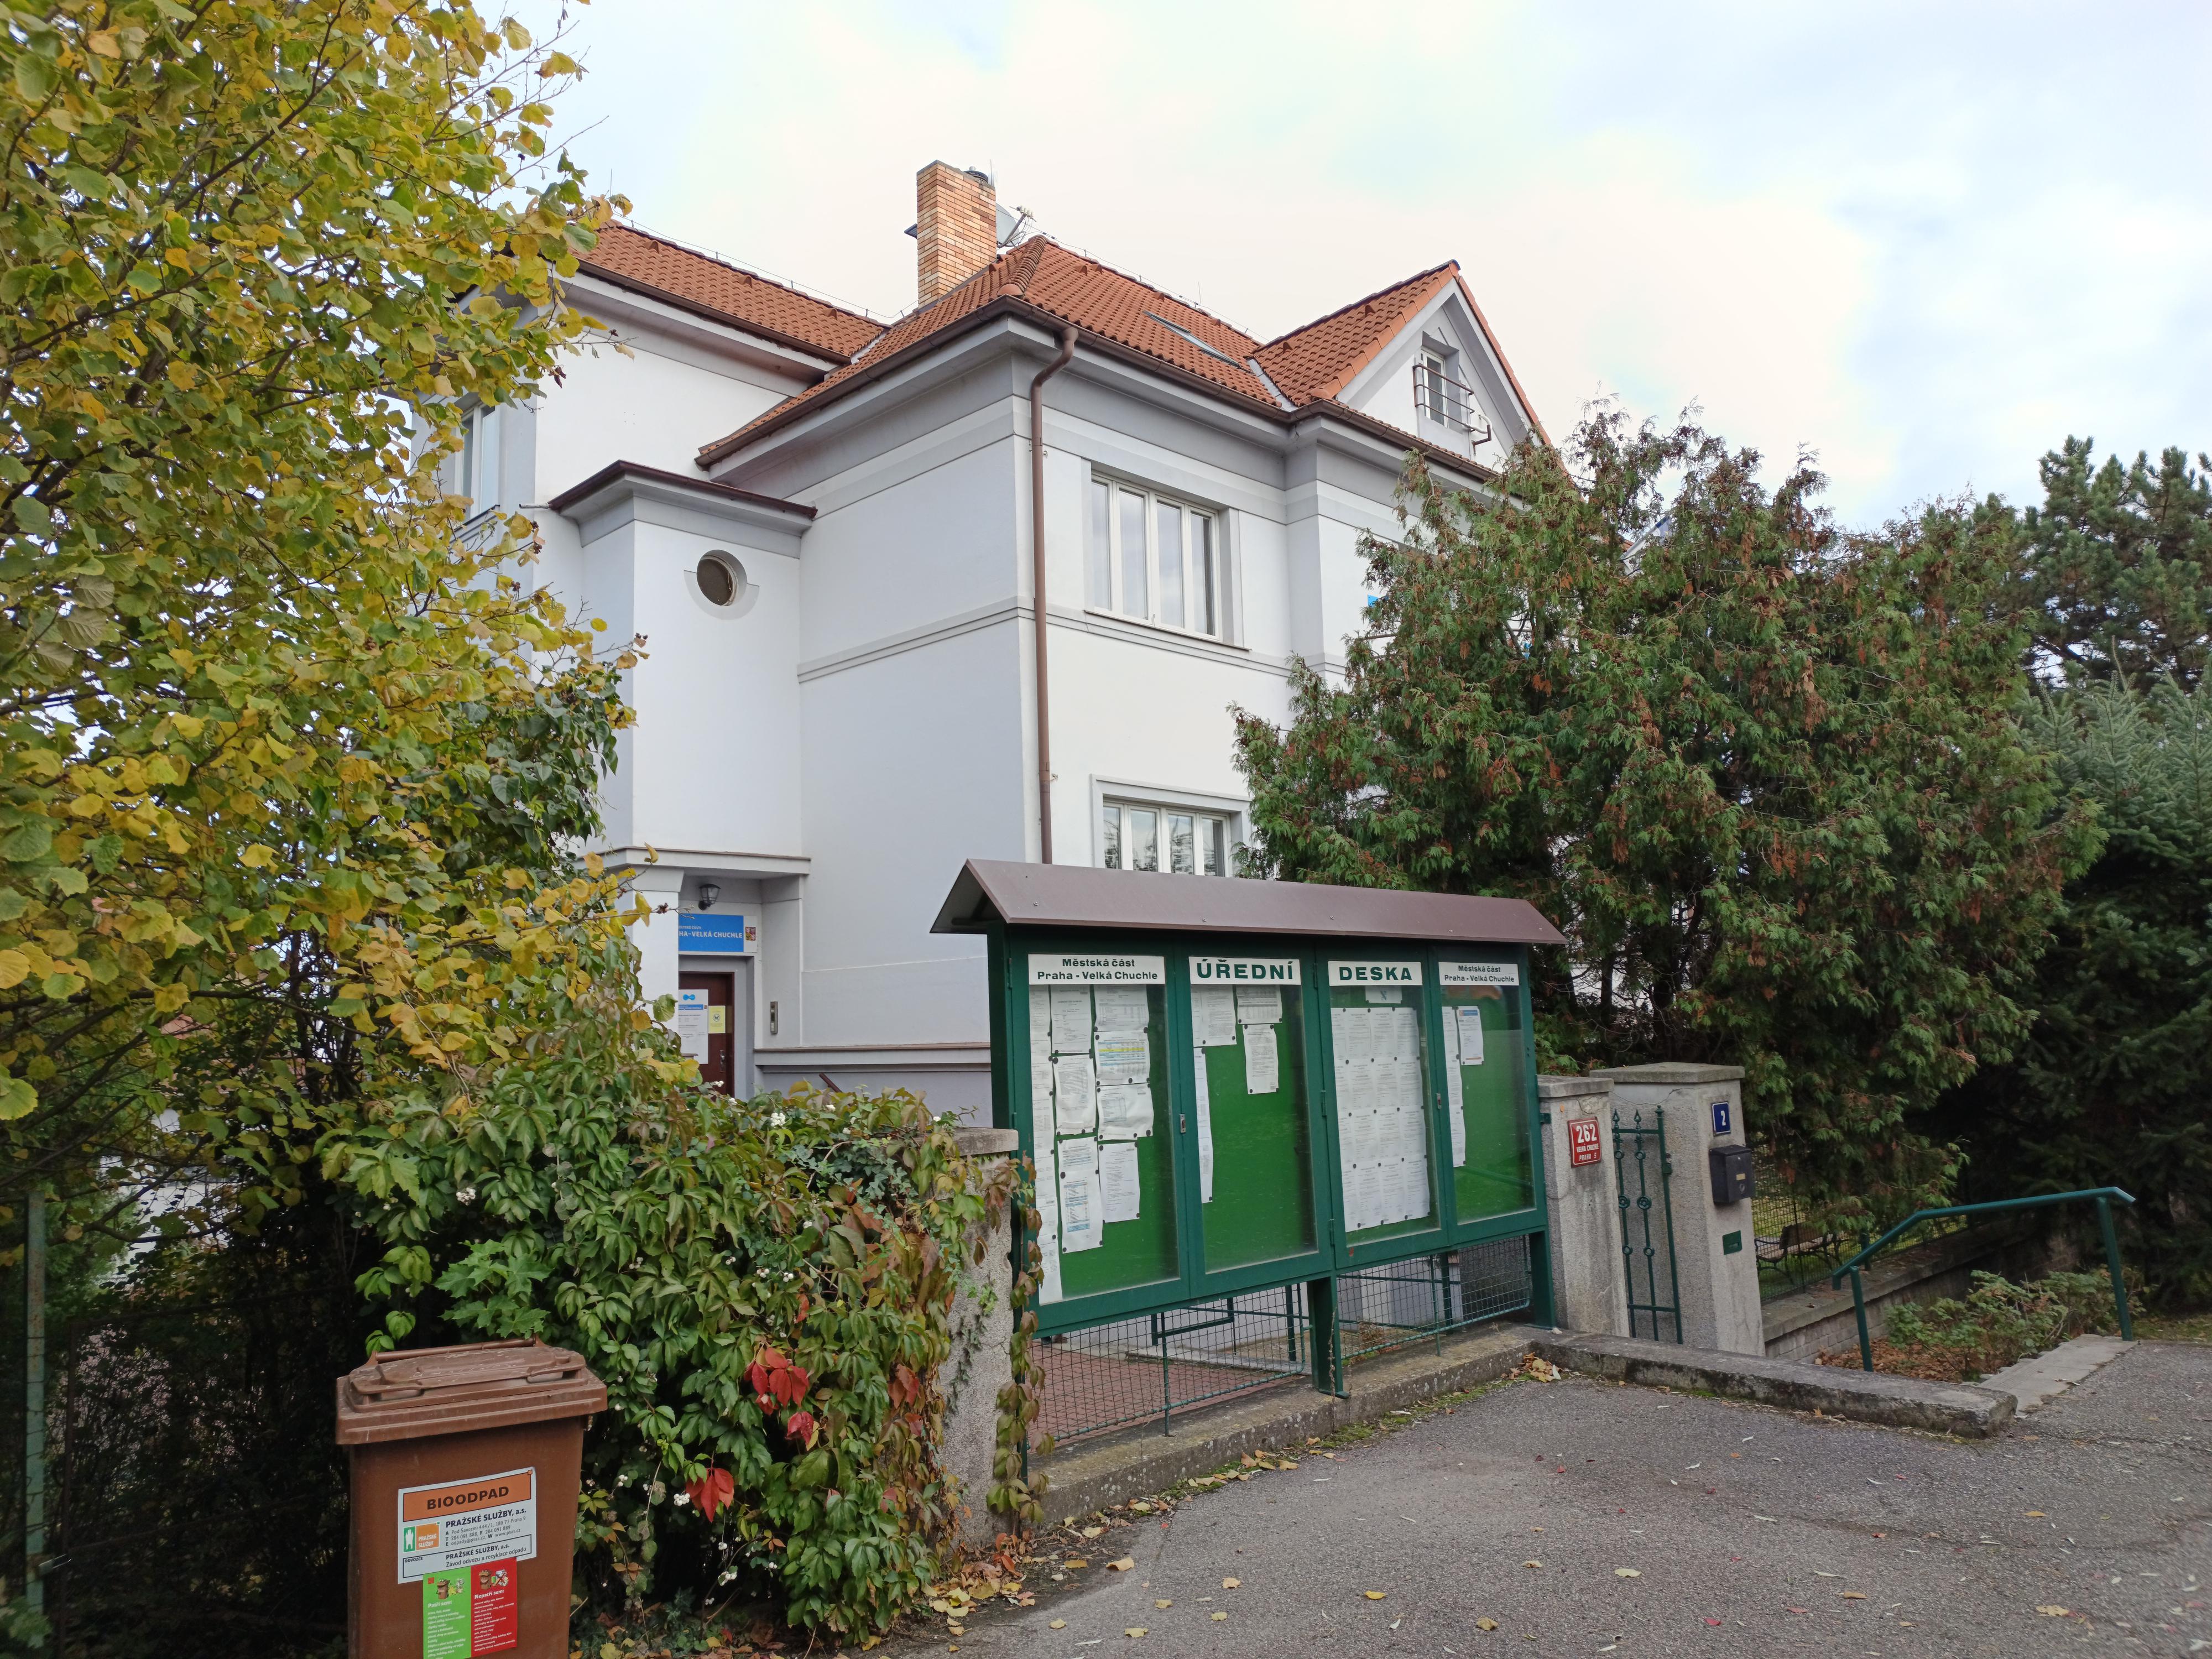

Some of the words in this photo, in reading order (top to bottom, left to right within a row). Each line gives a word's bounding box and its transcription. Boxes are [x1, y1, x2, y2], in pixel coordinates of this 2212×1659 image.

[1062, 958, 1109, 967] Městská
[1112, 958, 1135, 967] část
[1196, 959, 1293, 979] ÚŘEDNÍ
[1037, 971, 1073, 979] Praha
[1082, 971, 1112, 979] Velká
[1114, 971, 1158, 979] Chuchle
[1339, 967, 1412, 980] DESKA
[1720, 1110, 1726, 1126] 2
[1576, 1123, 1597, 1144] 262
[426, 1486, 509, 1510] BIOODPAD
[446, 1514, 482, 1528] PRAŽSKÉ
[483, 1509, 514, 1521] SLUŽBY,
[495, 1528, 521, 1537] www.psas.cz
[446, 1550, 474, 1559] PRAŽSKÉ
[475, 1545, 500, 1554] SLUŽBY,
[486, 1551, 508, 1561] recyklace
[509, 1547, 526, 1555] odpadu
[474, 1592, 493, 1600] Nepatří
